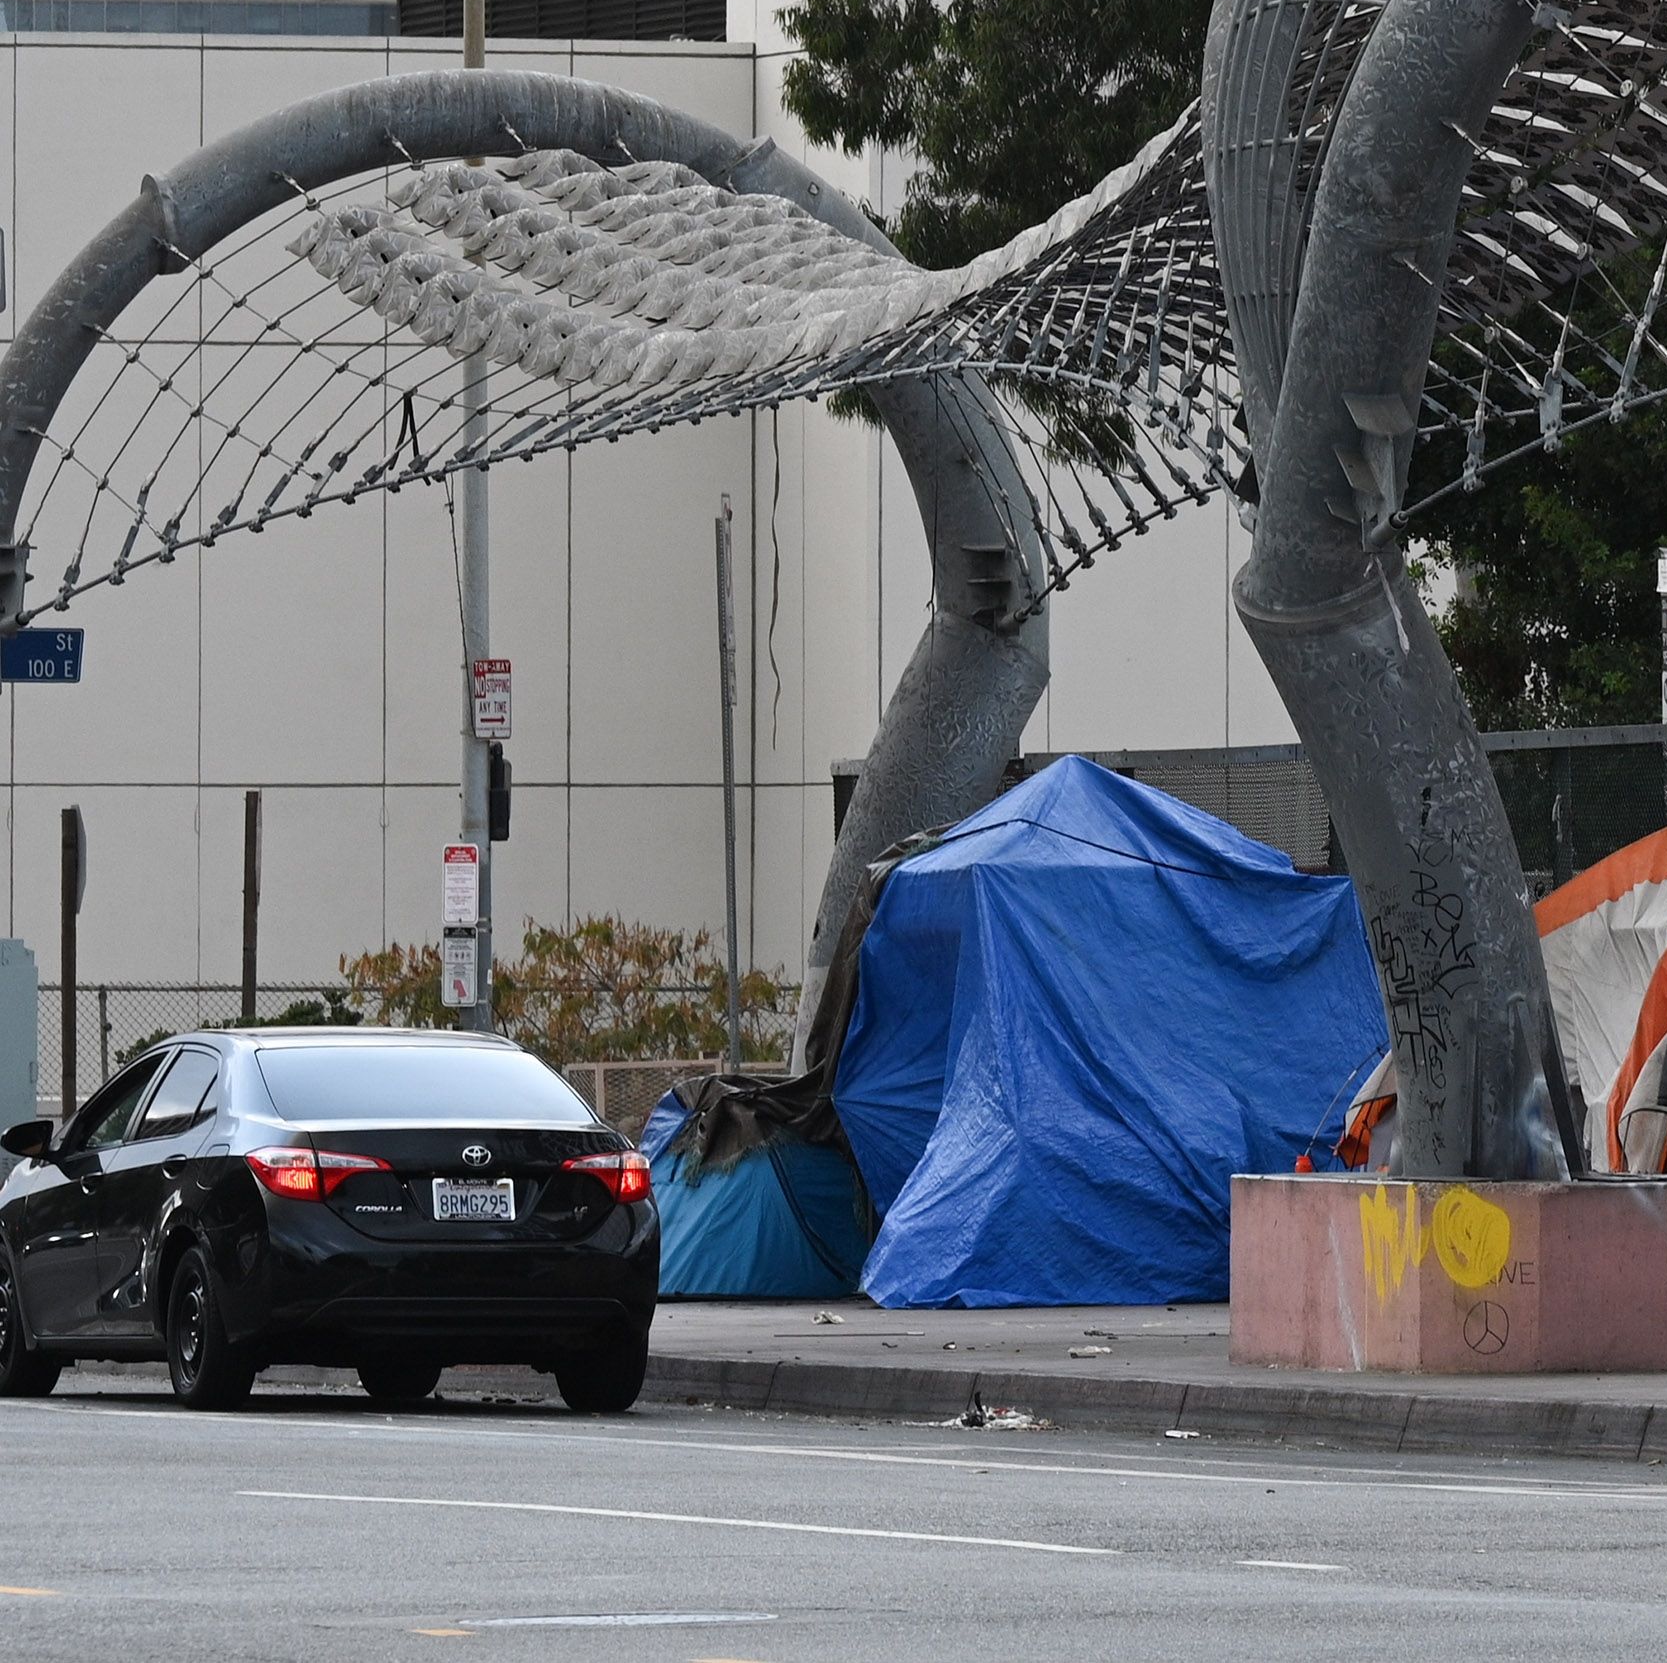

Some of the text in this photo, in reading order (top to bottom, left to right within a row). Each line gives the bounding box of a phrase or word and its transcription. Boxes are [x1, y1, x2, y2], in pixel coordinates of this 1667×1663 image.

[56, 633, 74, 652] St
[28, 659, 74, 678] 100 E
[474, 676, 486, 697] NO
[479, 701, 507, 714] ANY TIME
[355, 1204, 403, 1213] COROLLA
[440, 1194, 509, 1214] 8RMG295
